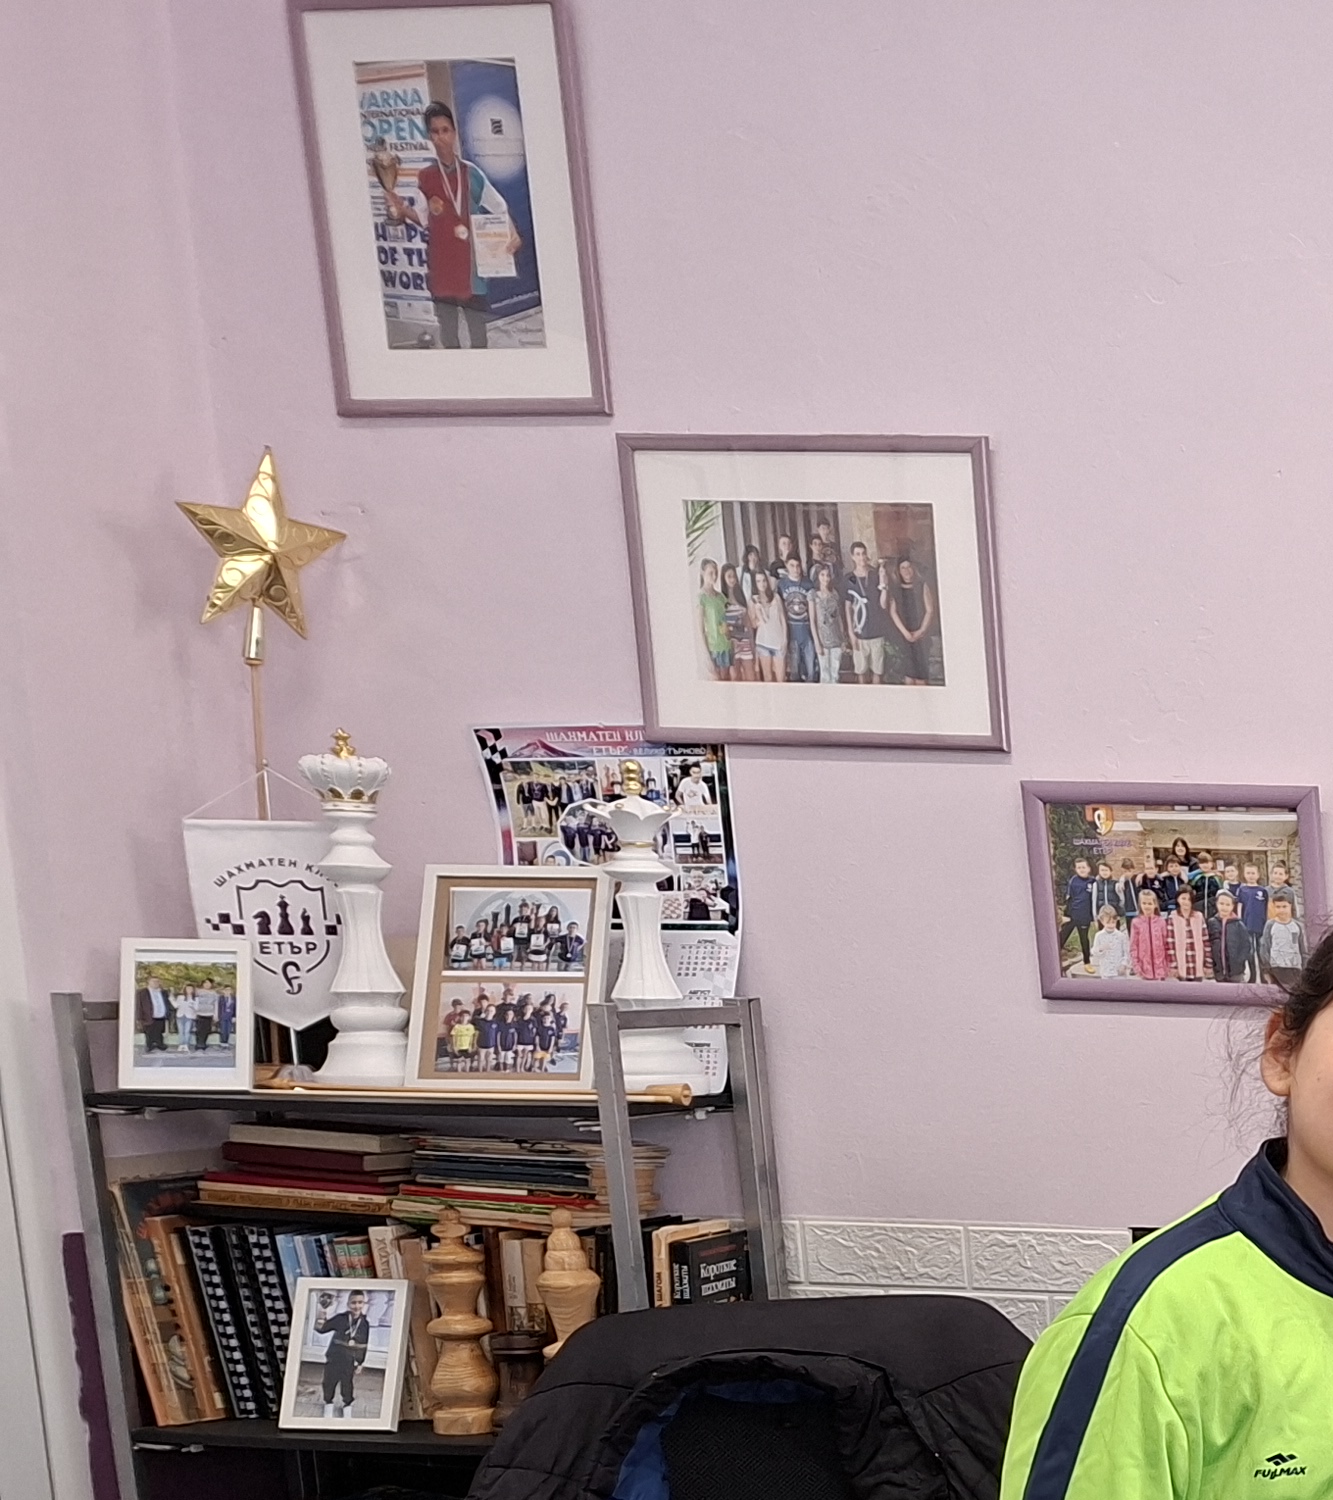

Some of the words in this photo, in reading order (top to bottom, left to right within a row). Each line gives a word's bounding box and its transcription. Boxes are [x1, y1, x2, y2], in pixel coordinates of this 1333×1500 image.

[374, 221, 429, 244] HPE
[380, 269, 427, 290] WOR
[213, 857, 298, 888] ШАХМАТЕН
[258, 941, 318, 955] ЕТЪР
